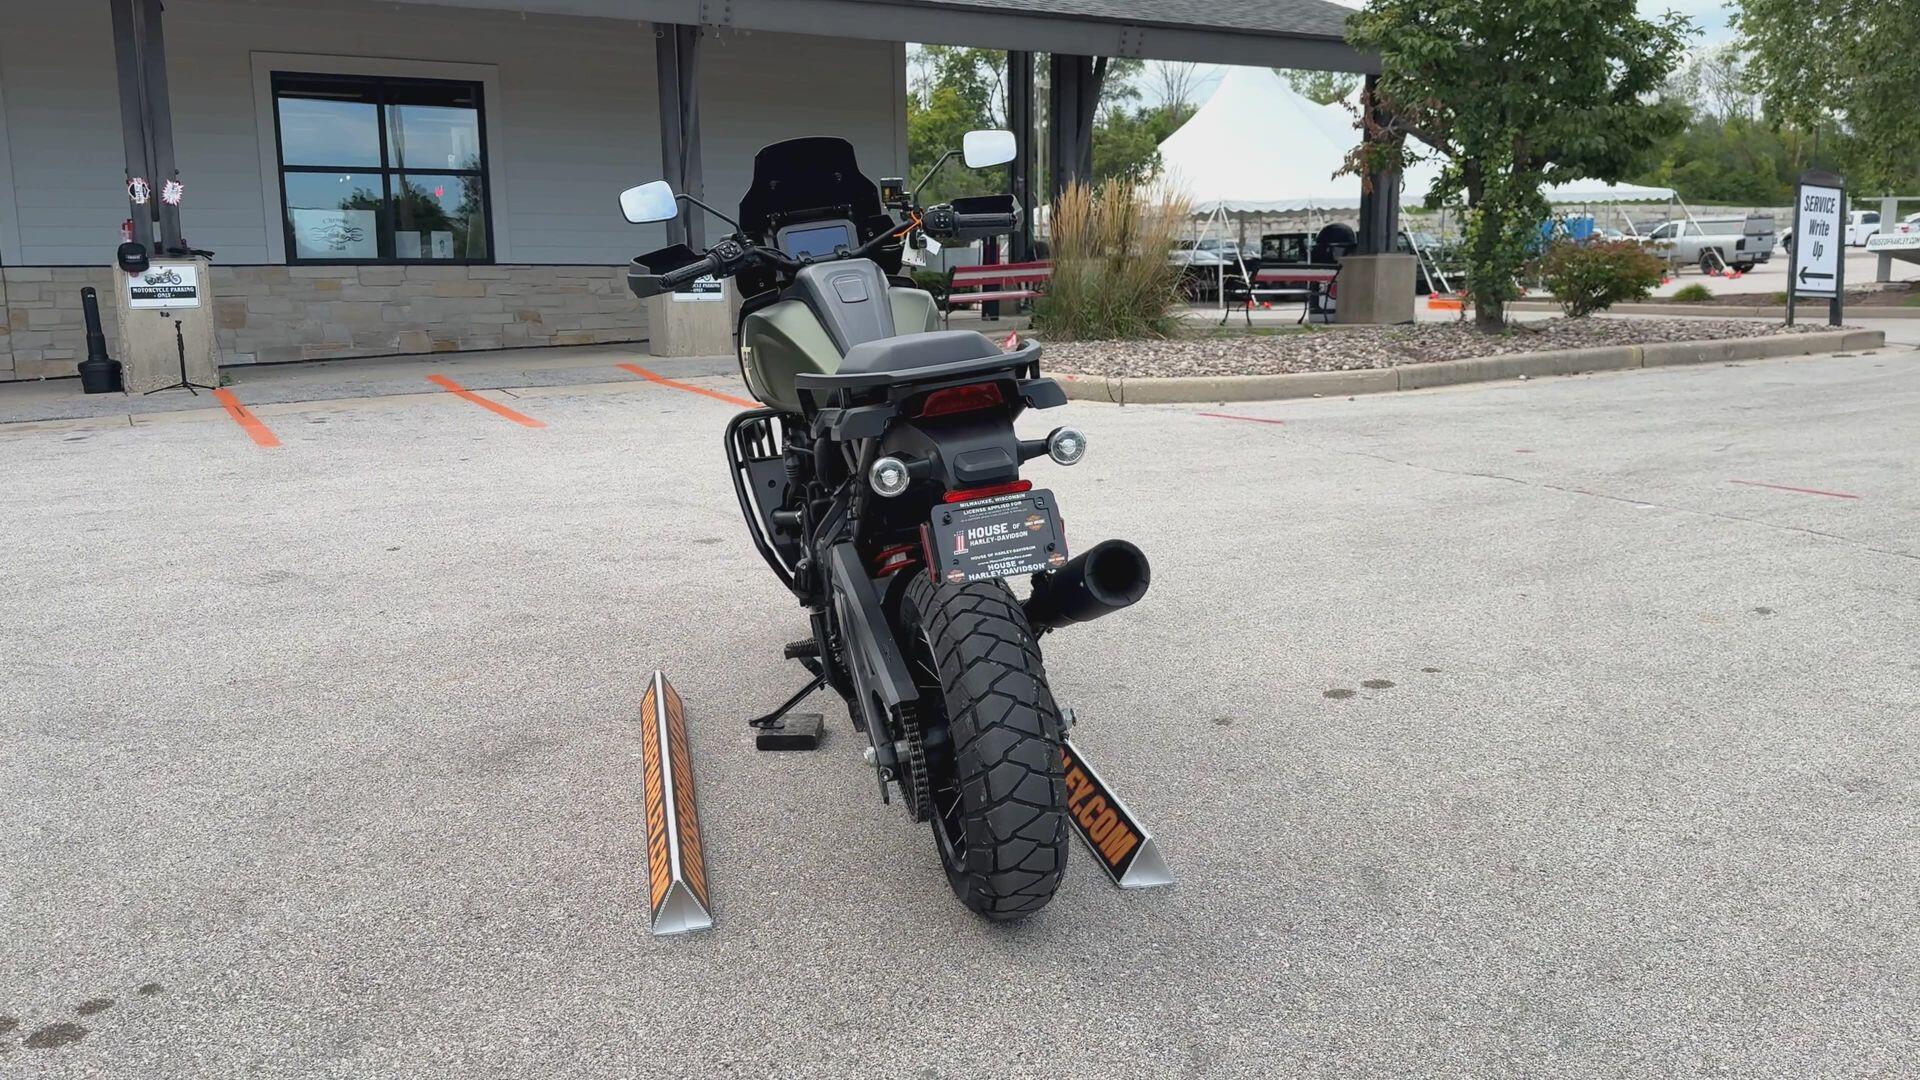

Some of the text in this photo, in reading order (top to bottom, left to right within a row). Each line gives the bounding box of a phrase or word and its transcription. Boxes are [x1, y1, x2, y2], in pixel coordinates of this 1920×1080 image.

[1804, 195, 1836, 214] SERVICE
[1808, 219, 1830, 236] Write
[1812, 241, 1824, 261] Up
[960, 493, 1026, 508] MILWAUKEE, WISCONSIN
[987, 502, 1010, 512] APPLIED
[968, 522, 1009, 539] HOUSE
[969, 530, 1028, 546] HARLEY-DAVIDSON
[994, 545, 1036, 556] HARLEY-DAVIDSON
[968, 562, 1045, 580] HARLEY-DAVIDSON
[987, 560, 1017, 571] HOUSE
[1061, 754, 1138, 866] EY.COM
